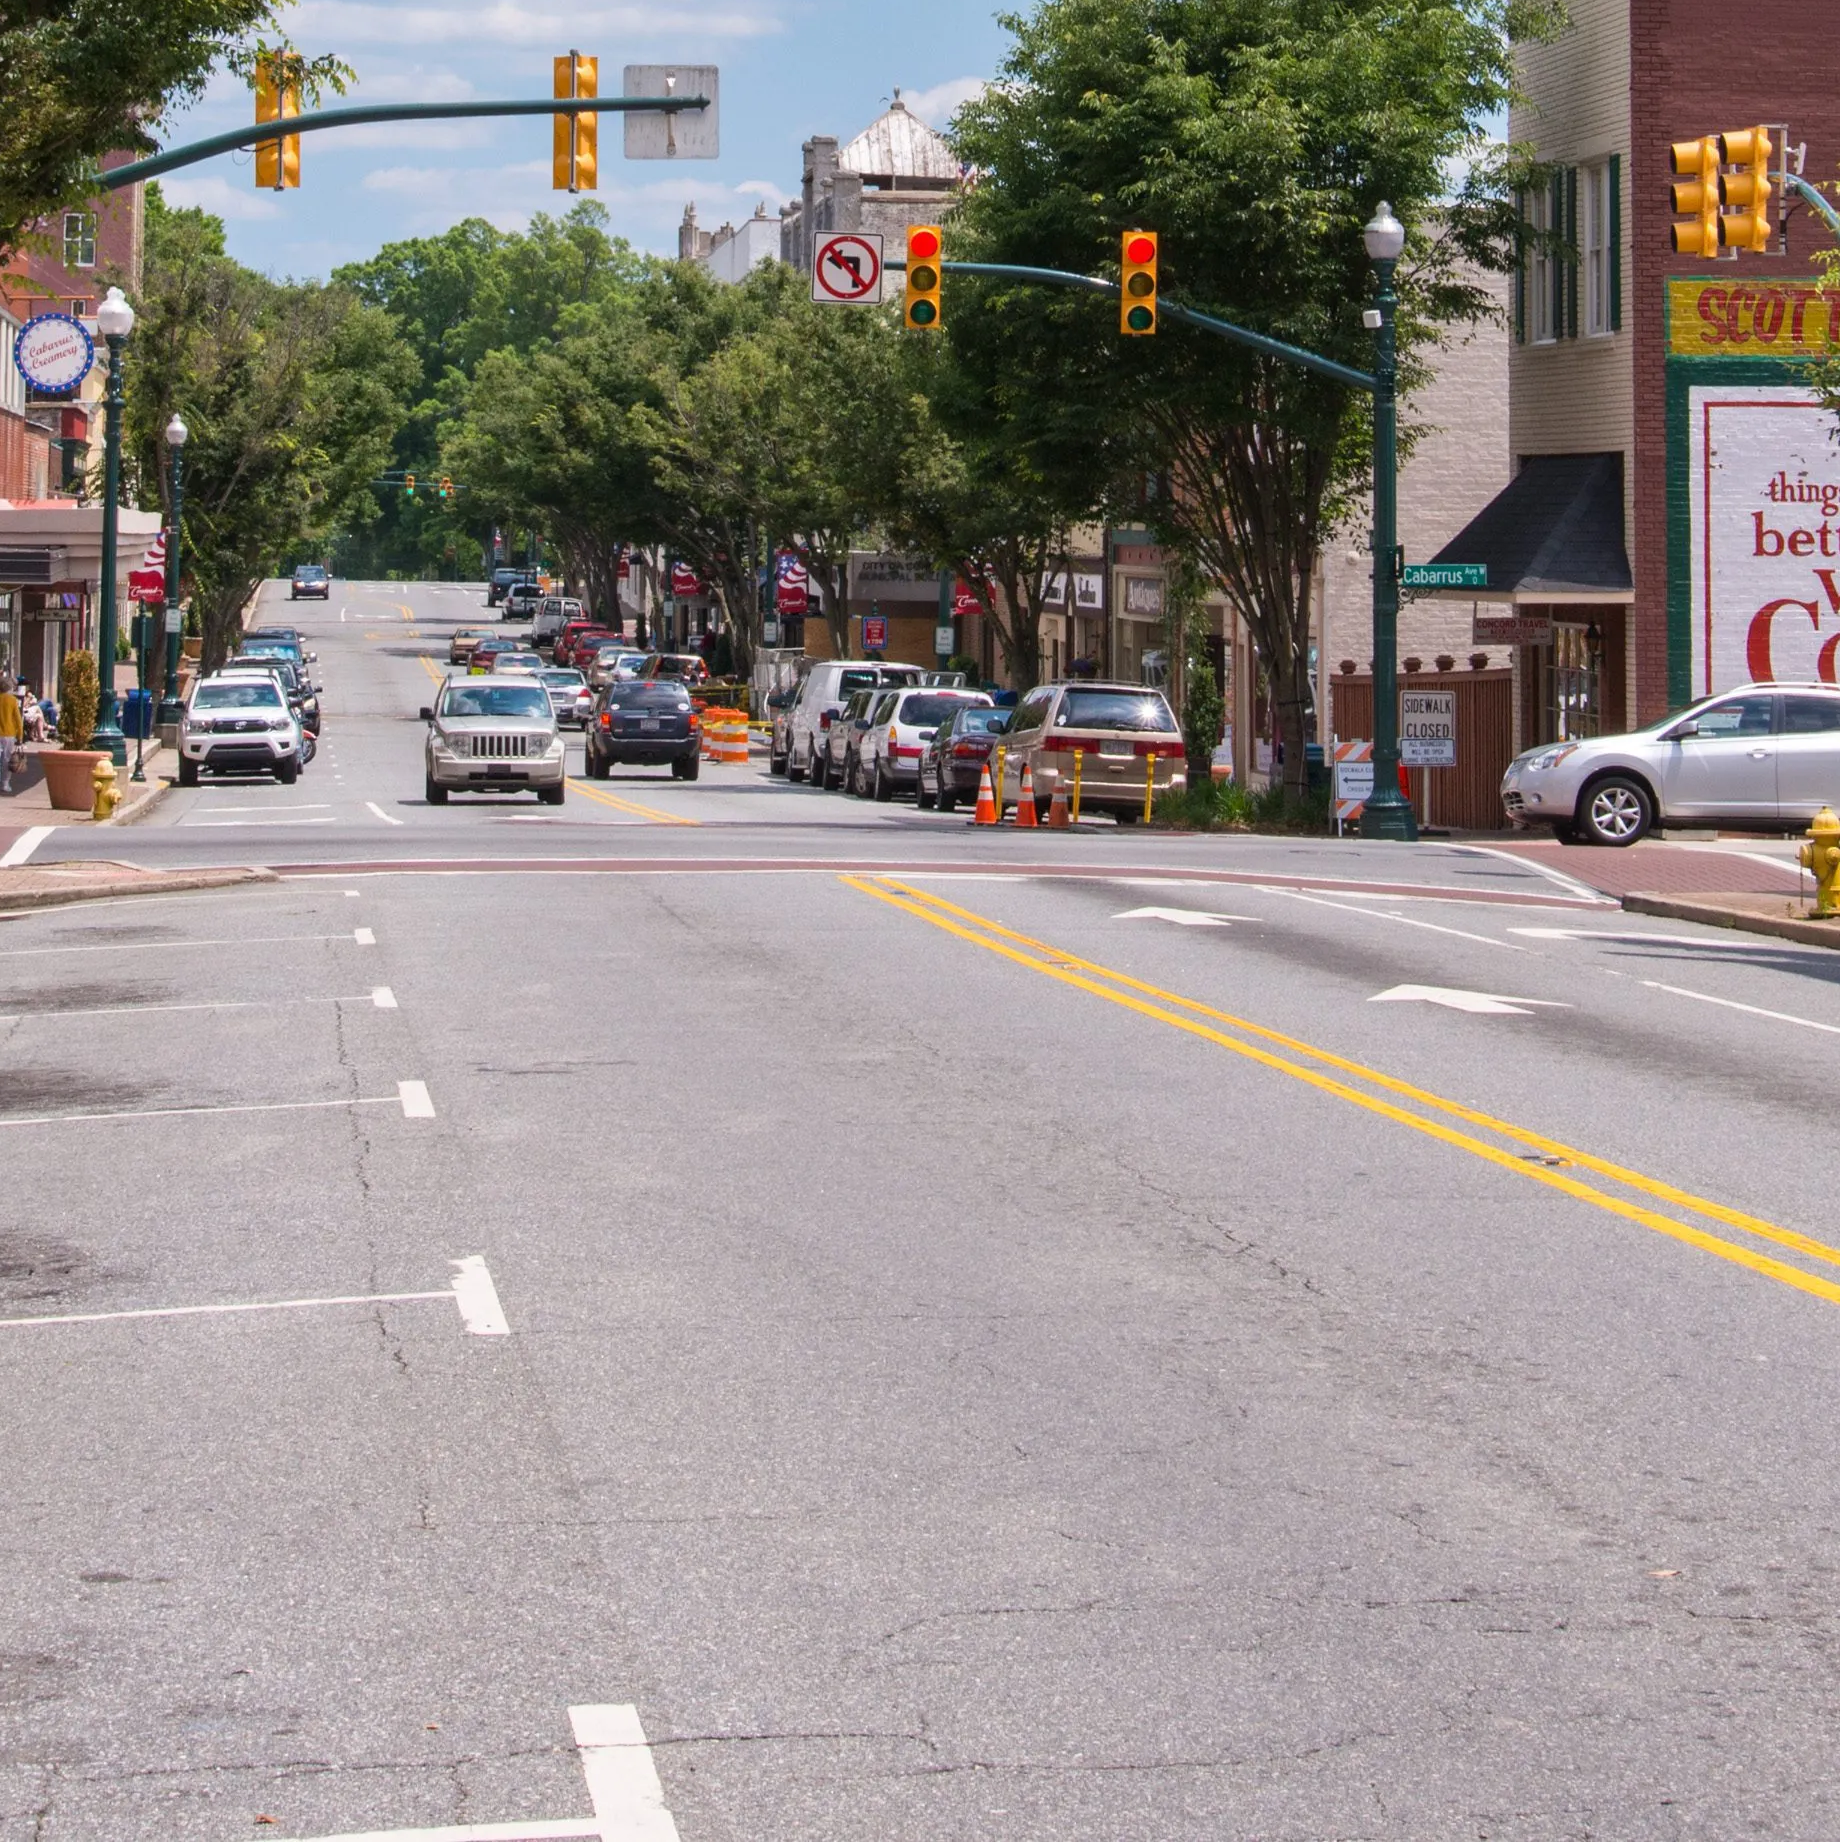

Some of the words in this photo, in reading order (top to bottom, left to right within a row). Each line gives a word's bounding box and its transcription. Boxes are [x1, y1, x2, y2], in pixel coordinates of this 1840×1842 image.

[29, 334, 74, 358] Cabarrus
[32, 345, 79, 370] Creamery
[1403, 567, 1463, 584] Cabarrus
[1464, 567, 1478, 575] Ave
[1476, 620, 1516, 629] CONCORD
[1519, 619, 1549, 629] TRAVEL
[1404, 698, 1451, 714] SIDEWALK
[1406, 723, 1450, 738] CLOSED
